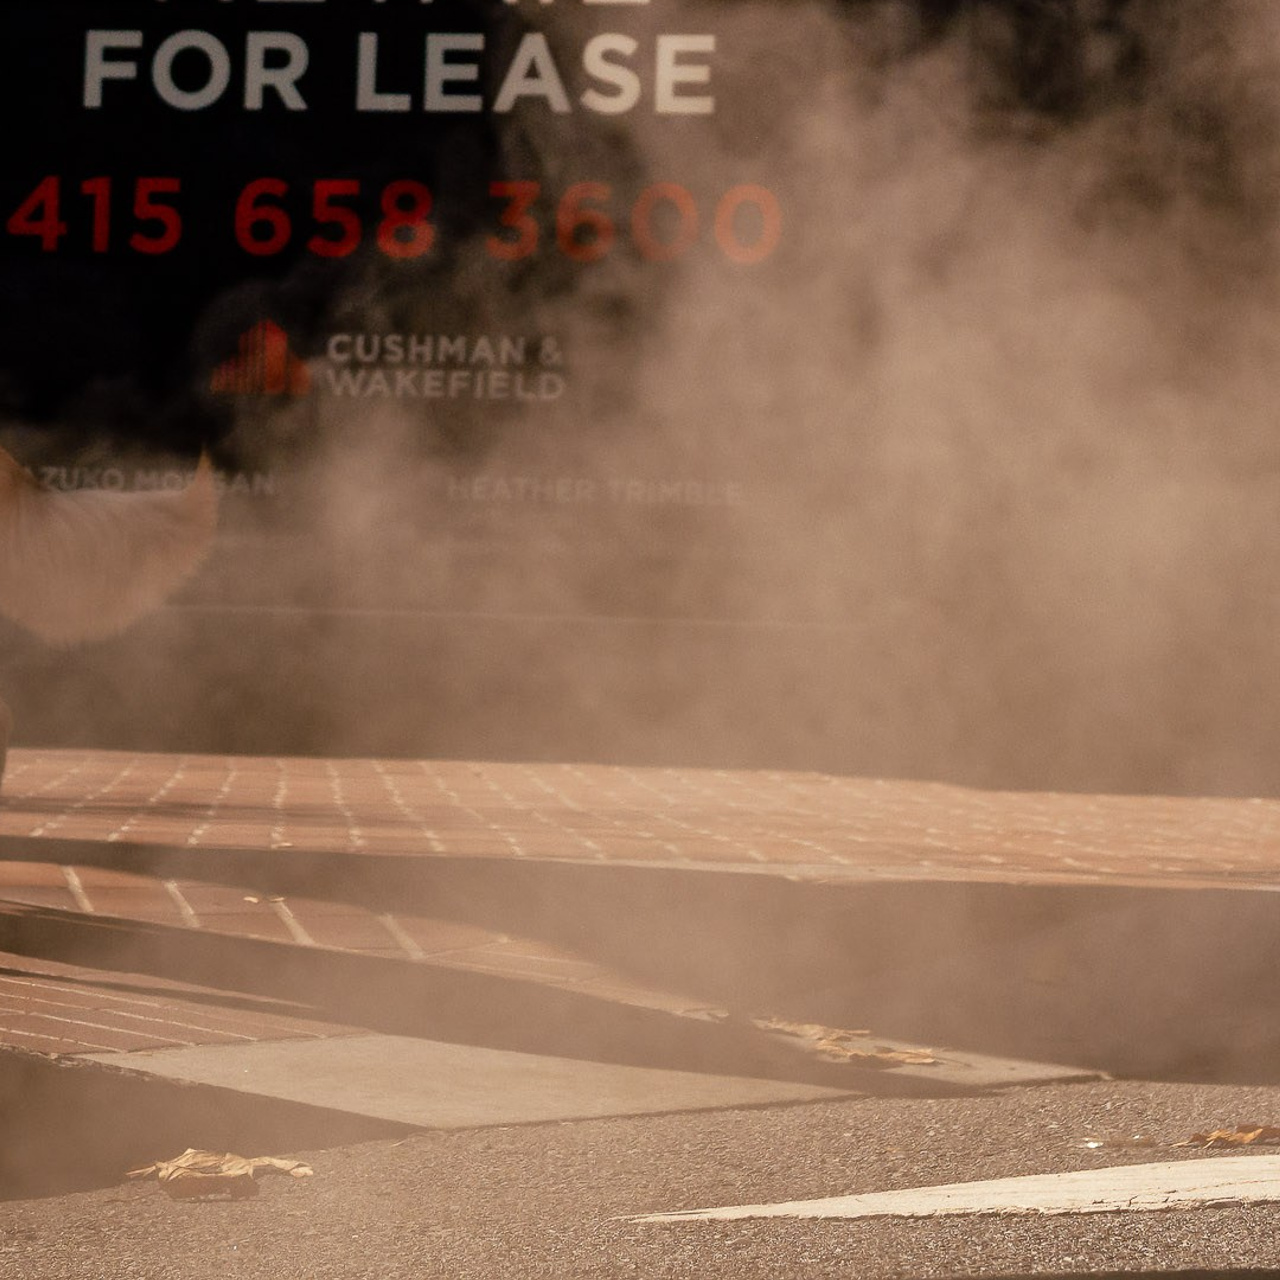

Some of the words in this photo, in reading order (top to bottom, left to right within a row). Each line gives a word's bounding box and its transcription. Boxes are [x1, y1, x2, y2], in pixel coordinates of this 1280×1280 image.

[83, 29, 310, 110] FOR
[356, 32, 717, 114] LEASE
[7, 175, 184, 255] 415
[233, 177, 437, 259] 658
[484, 181, 784, 264] 3600
[326, 333, 527, 364] CUSHMAN
[538, 335, 561, 365] &
[326, 369, 567, 400] WAKEFIELD
